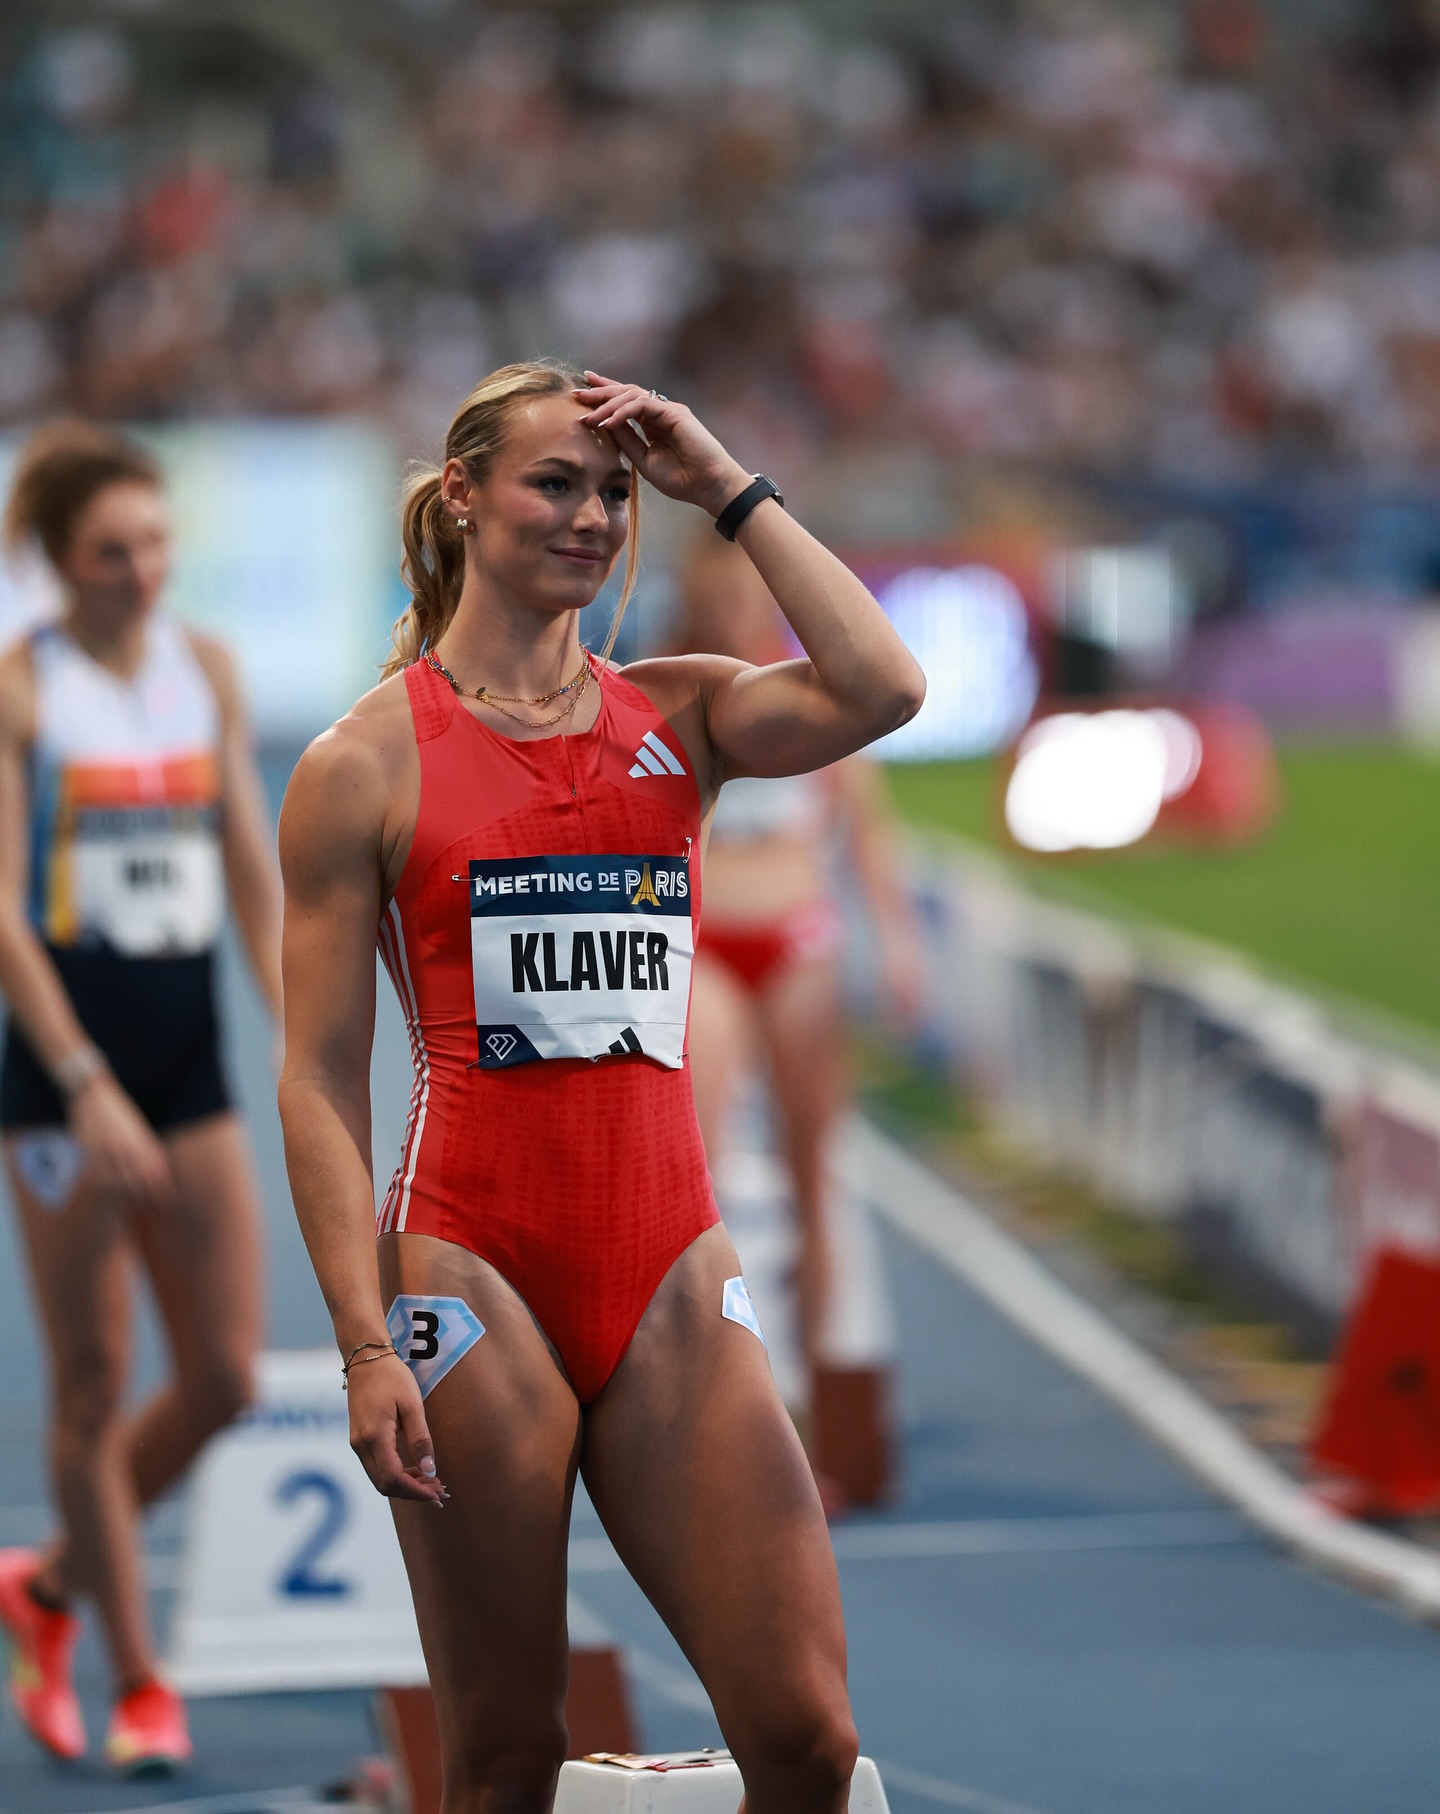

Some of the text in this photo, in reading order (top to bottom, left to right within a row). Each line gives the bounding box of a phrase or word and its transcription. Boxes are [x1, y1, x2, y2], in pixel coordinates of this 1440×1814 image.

[475, 863, 688, 906] MEETING DE PARIS
[510, 930, 670, 992] KLAVER
[408, 1310, 440, 1360] 3
[274, 1470, 352, 1599] 2
